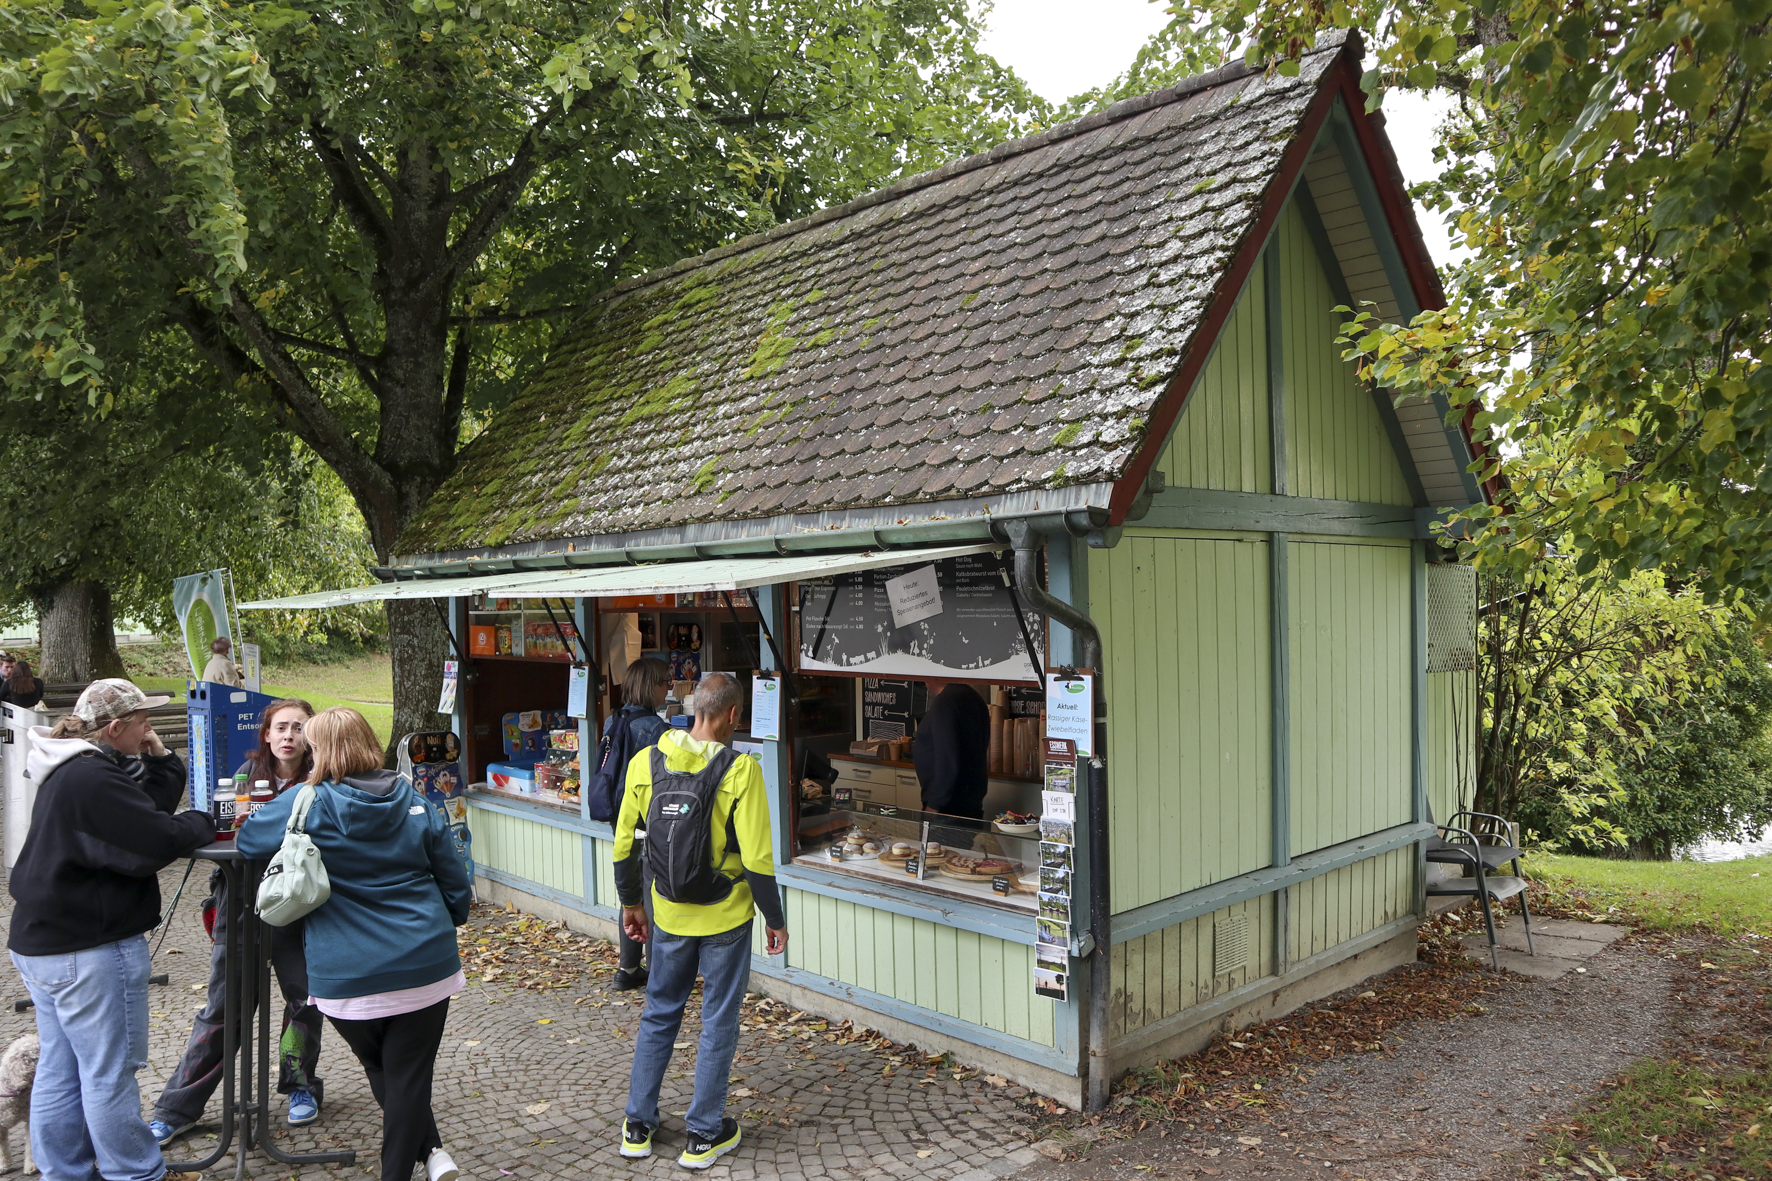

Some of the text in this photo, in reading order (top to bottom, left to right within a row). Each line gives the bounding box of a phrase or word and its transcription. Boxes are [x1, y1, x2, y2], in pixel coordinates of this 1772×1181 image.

[903, 580, 920, 592] Heute:
[900, 590, 928, 604] Reduziertes
[897, 597, 935, 616] Speisenangebot!
[864, 678, 879, 689] PIZZA
[864, 690, 896, 705] SANDWICHES
[864, 705, 883, 718] SALATE
[1057, 703, 1078, 711] Aktuell:
[1048, 714, 1070, 723] Rassiger
[1048, 725, 1088, 735] Zwiebelfladen
